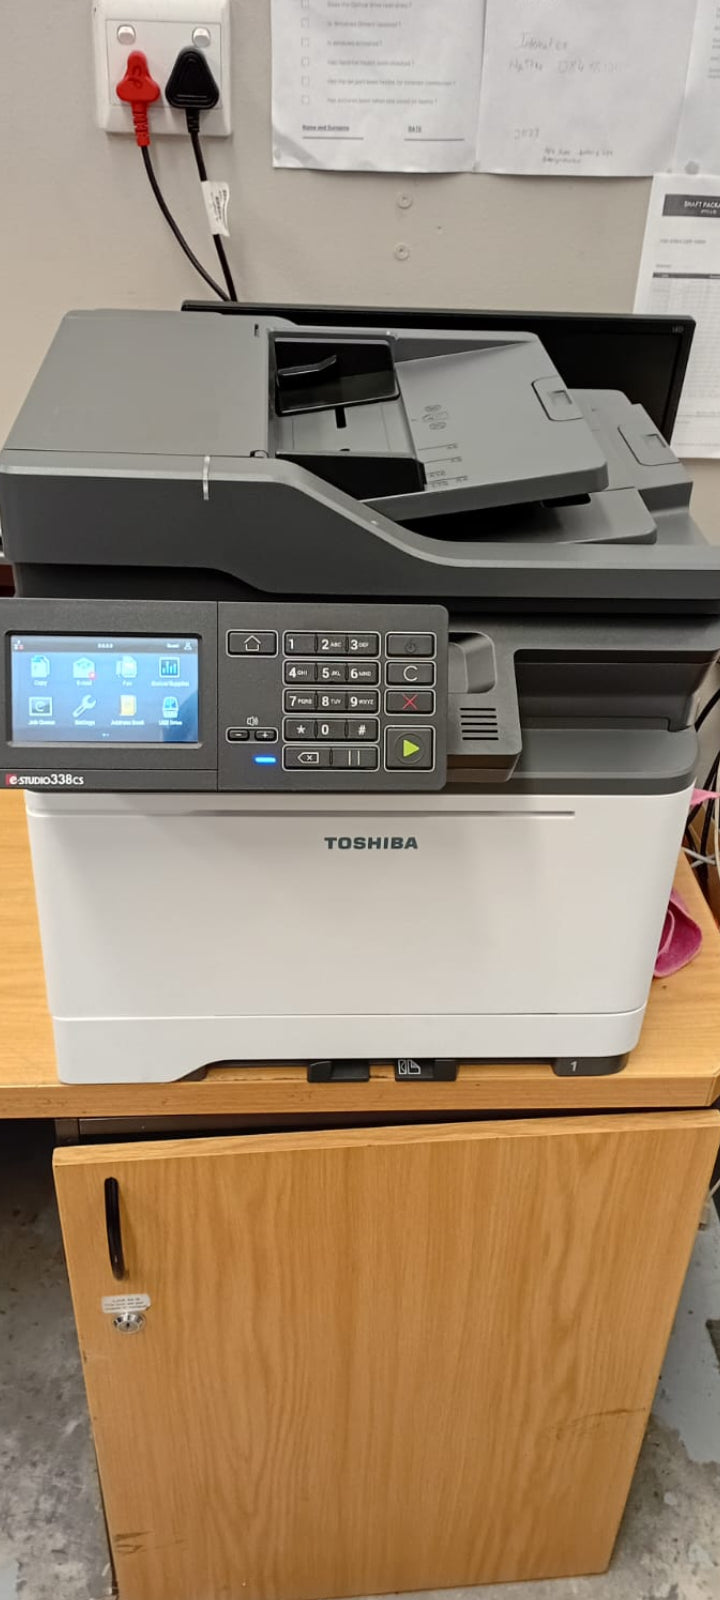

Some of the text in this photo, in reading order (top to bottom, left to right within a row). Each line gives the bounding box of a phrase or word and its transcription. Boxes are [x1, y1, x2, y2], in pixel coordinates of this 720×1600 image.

[288, 639, 295, 650] 1
[321, 639, 329, 650] 2
[350, 639, 358, 650] 3
[288, 667, 297, 679] 4
[322, 667, 330, 679] 5
[350, 668, 358, 679] 6
[289, 695, 297, 707] 7
[321, 695, 330, 707] 8
[350, 696, 358, 707] 9
[75, 719, 96, 728] Settings
[111, 719, 131, 727] Address
[321, 724, 329, 735] 0
[323, 836, 418, 850] TOSHIBA
[570, 1060, 577, 1072] 1
